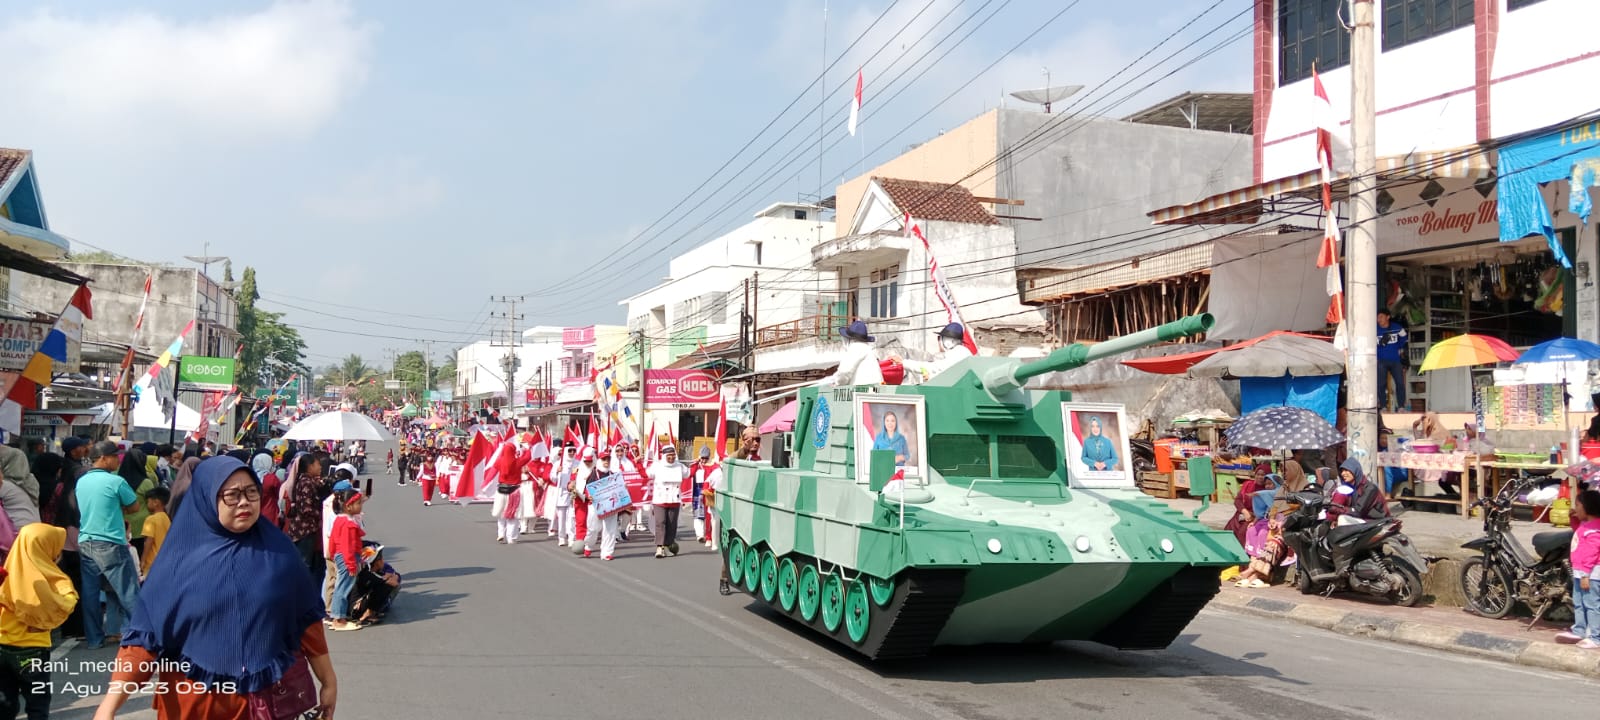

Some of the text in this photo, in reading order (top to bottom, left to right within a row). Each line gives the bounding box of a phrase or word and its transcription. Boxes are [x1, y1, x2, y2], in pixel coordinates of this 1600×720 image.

[1396, 215, 1419, 226] TOKO
[1418, 207, 1477, 236] Bolang
[186, 364, 228, 376] ROBOT
[656, 386, 677, 394] GAS
[683, 380, 715, 392] HOCK
